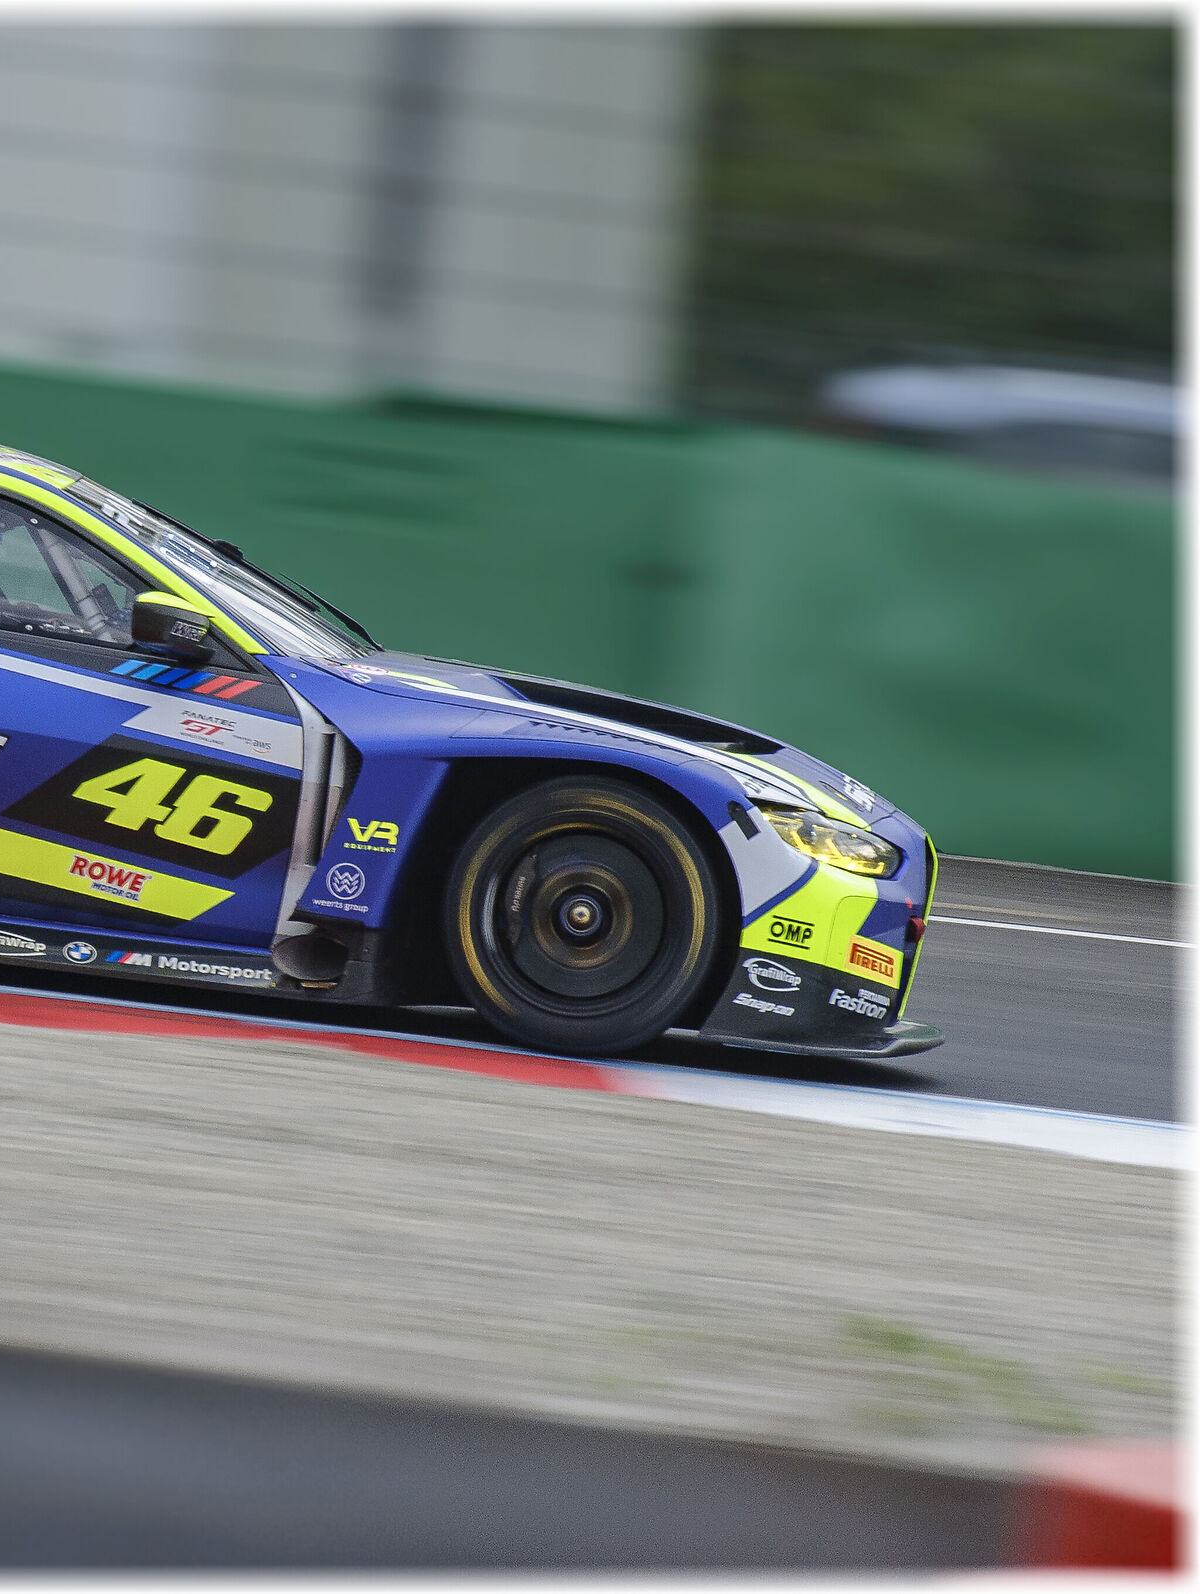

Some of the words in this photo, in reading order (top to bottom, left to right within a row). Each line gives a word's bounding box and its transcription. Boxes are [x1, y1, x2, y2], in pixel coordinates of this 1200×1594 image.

[181, 710, 237, 728] FANATEC
[72, 758, 273, 855] 46
[347, 818, 399, 846] VR
[69, 855, 146, 893] ROWE
[92, 882, 125, 897] MOTOR
[125, 892, 140, 901] OIL
[344, 903, 369, 914] group
[770, 920, 814, 944] OMP
[158, 955, 273, 980] Motorsport
[850, 943, 894, 978] PIRELLI
[828, 988, 888, 1020] Fastron
